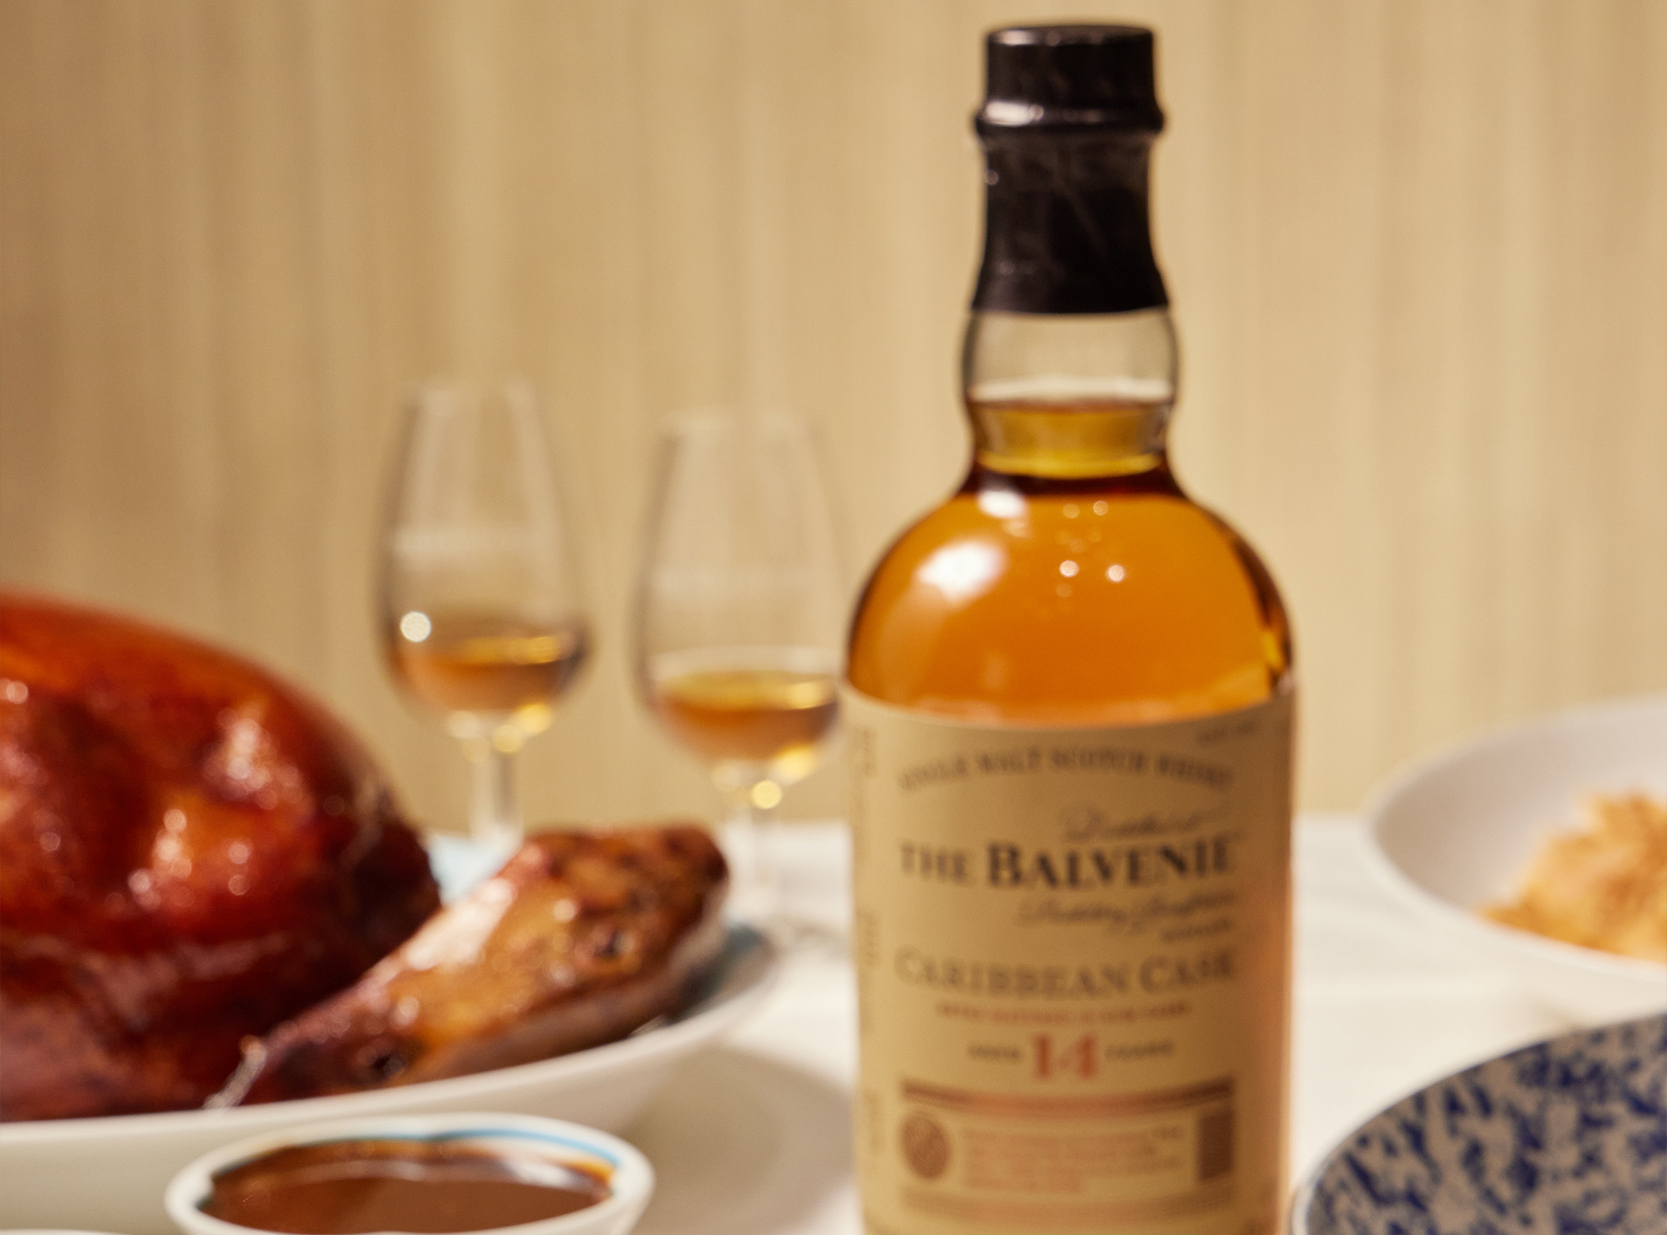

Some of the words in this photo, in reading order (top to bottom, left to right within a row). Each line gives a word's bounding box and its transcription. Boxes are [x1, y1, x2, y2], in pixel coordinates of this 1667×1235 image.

[899, 840, 975, 887] THE
[987, 832, 1239, 889] BALVENIE
[894, 945, 1130, 997] CARIBBEAN
[1139, 944, 1237, 993] CASK
[1033, 1033, 1097, 1080] 14
